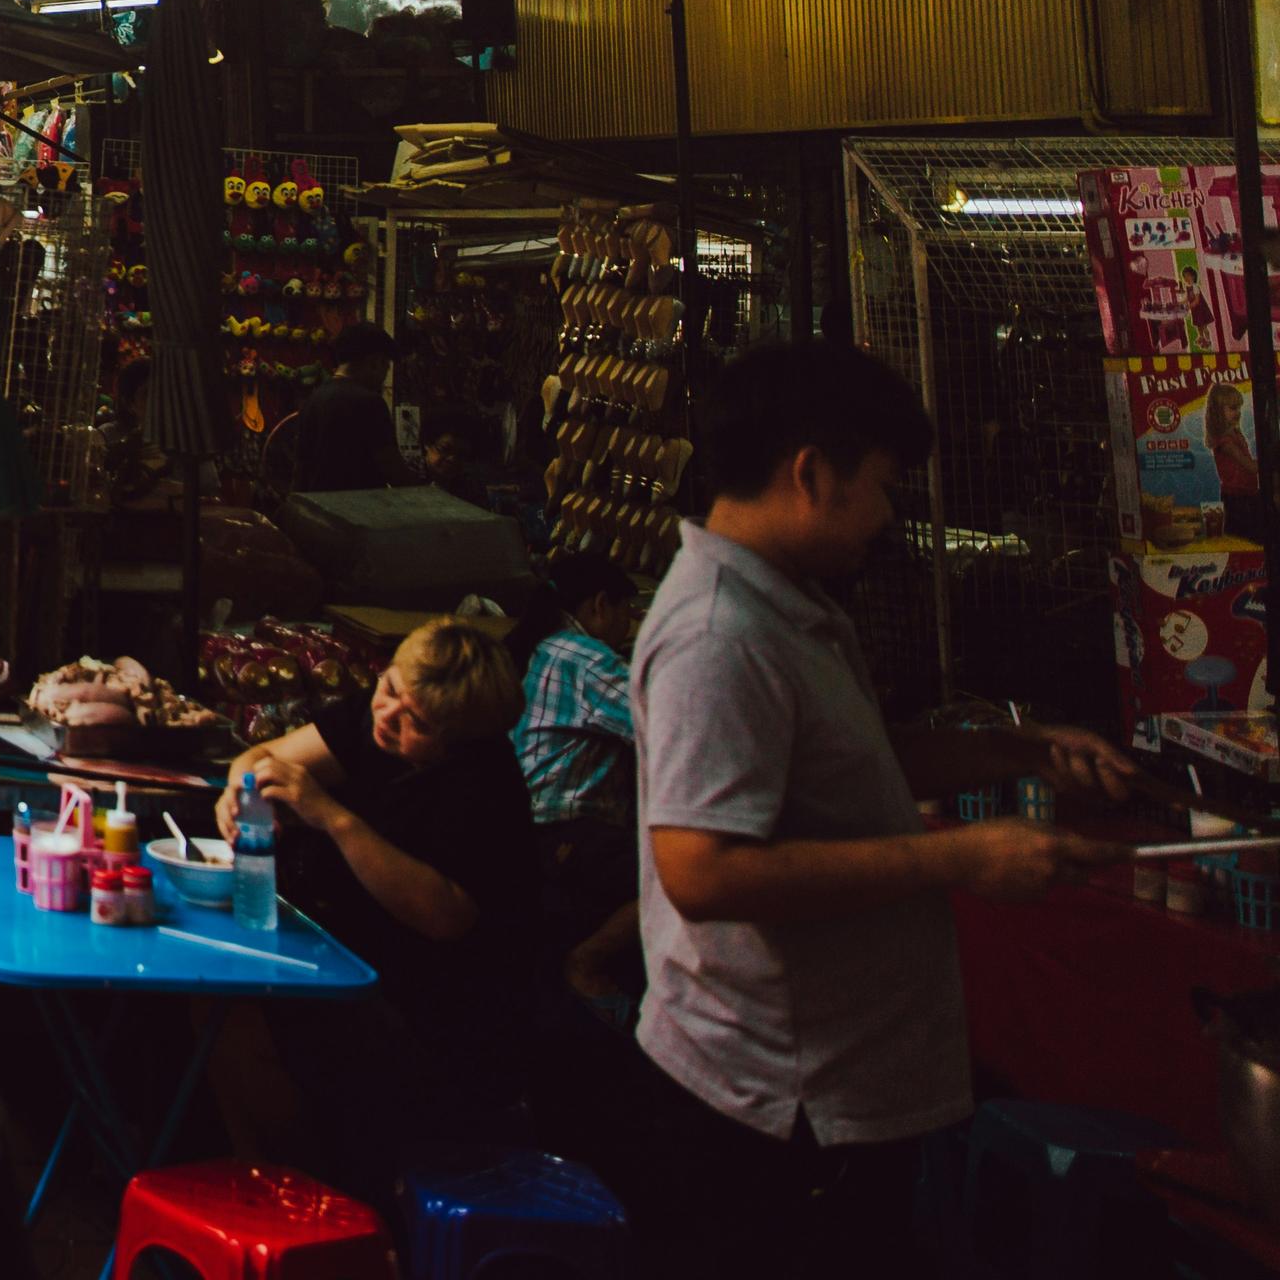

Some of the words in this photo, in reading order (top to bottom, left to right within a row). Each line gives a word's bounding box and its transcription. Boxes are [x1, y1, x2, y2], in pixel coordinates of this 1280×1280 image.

[1119, 185, 1206, 214] KITCHEN
[1140, 372, 1188, 395] Fast
[1194, 361, 1250, 387] Food
